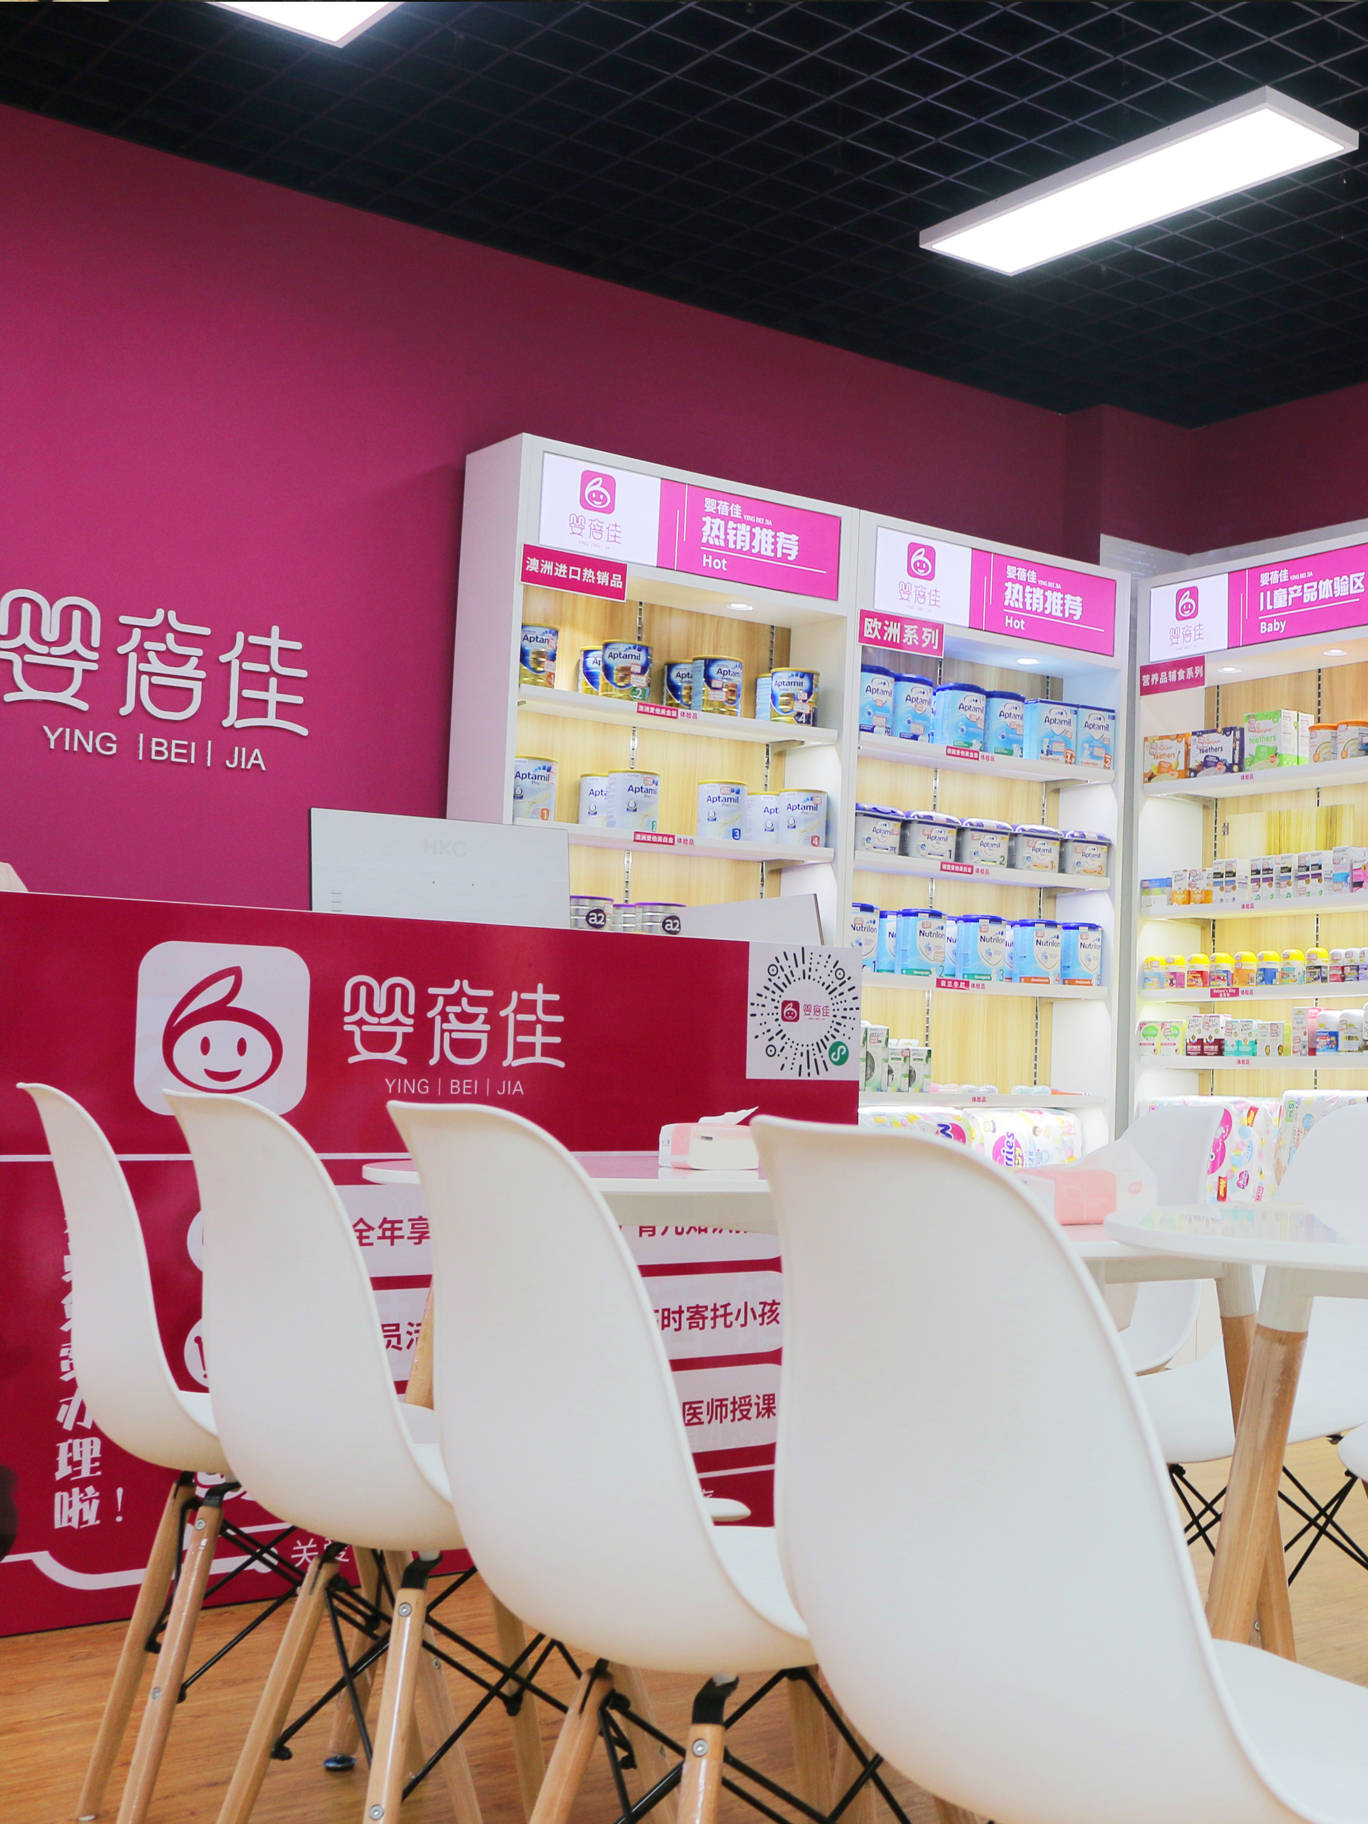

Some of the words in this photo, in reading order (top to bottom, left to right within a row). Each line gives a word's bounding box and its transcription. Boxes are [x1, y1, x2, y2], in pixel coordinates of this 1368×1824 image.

[701, 516, 799, 561] 热销推荐
[703, 553, 728, 571] Hot
[526, 556, 623, 588] 澳洲进口热销品
[1259, 572, 1365, 611] 儿童产品体验区
[1003, 581, 1083, 620] 热销推荐
[1005, 615, 1025, 630] Hot
[1260, 619, 1286, 634] Baby
[864, 617, 939, 649] 欧洲系列
[607, 651, 641, 661] Aptamil
[1142, 665, 1204, 686] 营养品辅食系列
[1044, 716, 1072, 727] Aptamil
[42, 725, 117, 756] YING
[225, 746, 267, 771] JIA
[514, 770, 550, 782] Aptamil
[706, 795, 739, 804] Aptamil
[786, 803, 819, 813] Aptamil
[588, 911, 606, 926] a2
[664, 918, 681, 933] a2
[385, 1077, 430, 1095] YING
[450, 1078, 478, 1095] BEI
[497, 1078, 524, 1096] JIA
